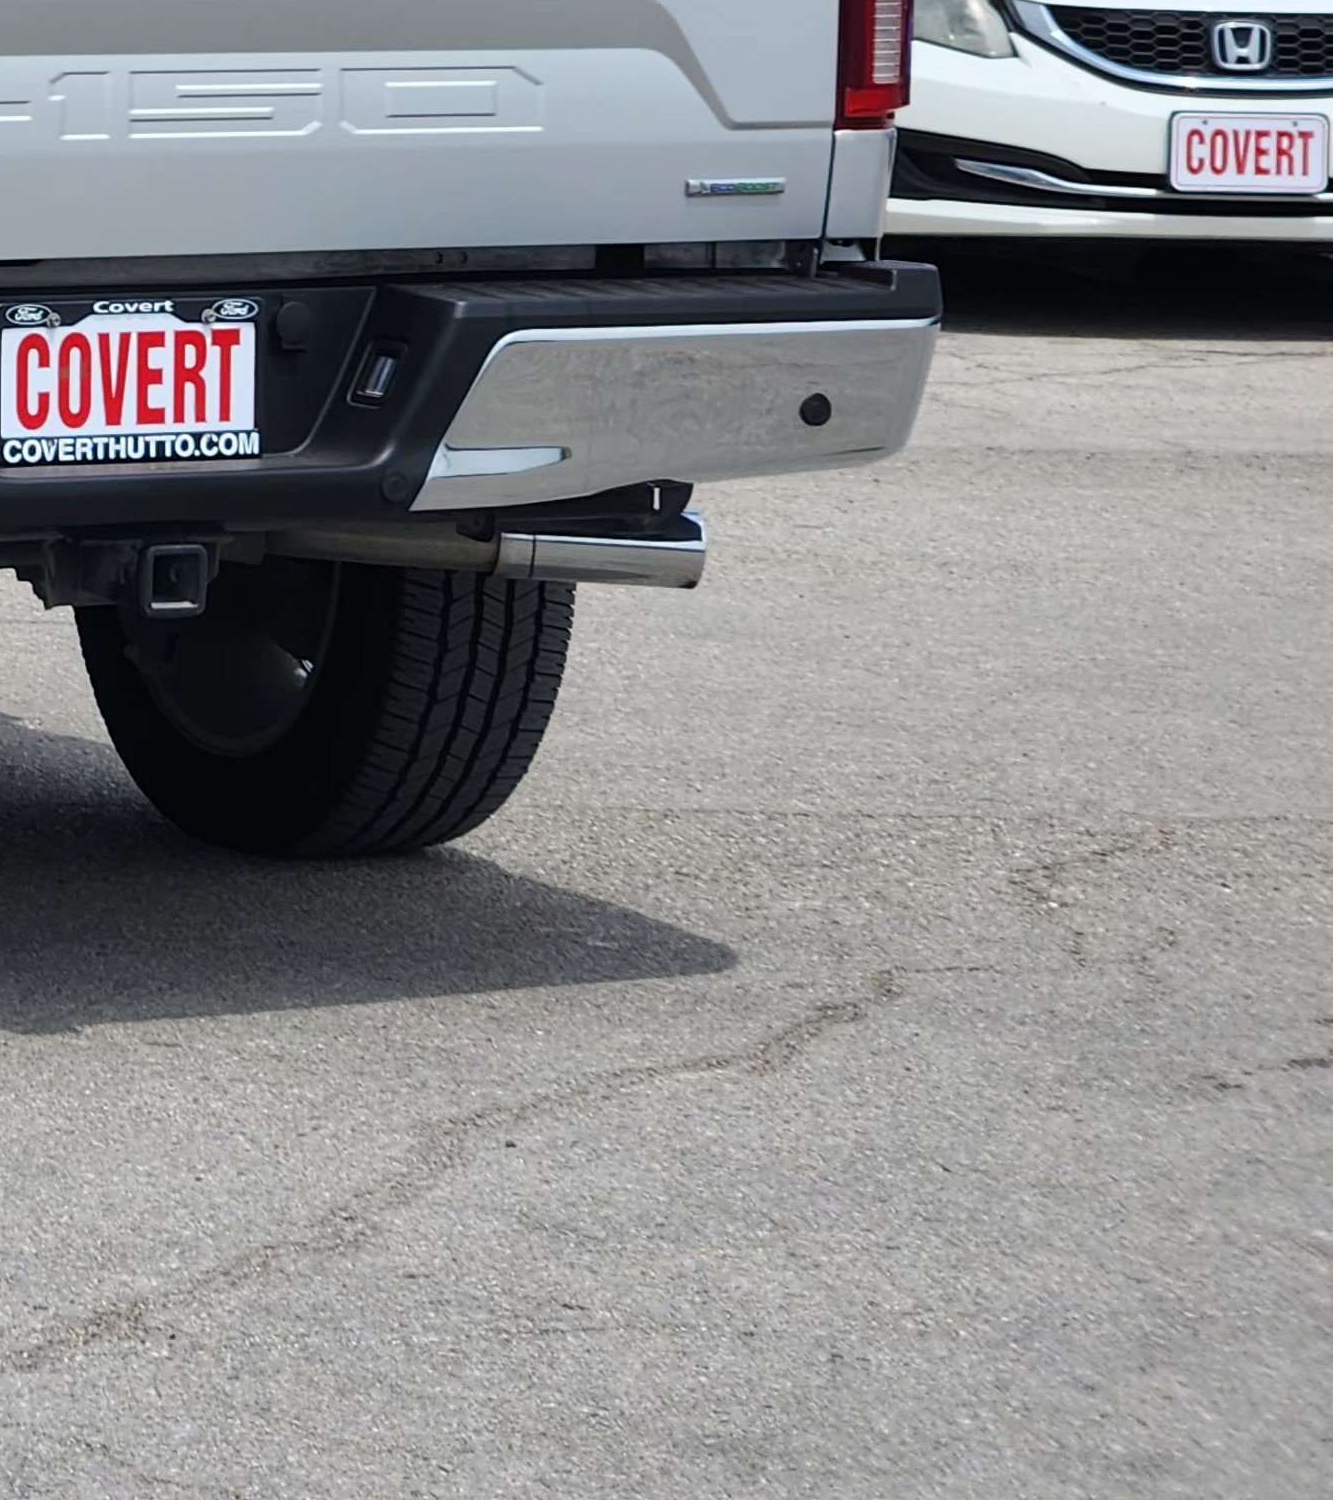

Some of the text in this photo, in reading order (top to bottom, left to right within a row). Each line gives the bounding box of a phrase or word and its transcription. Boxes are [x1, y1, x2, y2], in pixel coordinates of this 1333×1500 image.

[1185, 127, 1315, 177] COVERT
[92, 299, 175, 314] Covert
[15, 327, 241, 431] COVERT
[2, 431, 260, 464] COVERTHUTTO.COM
